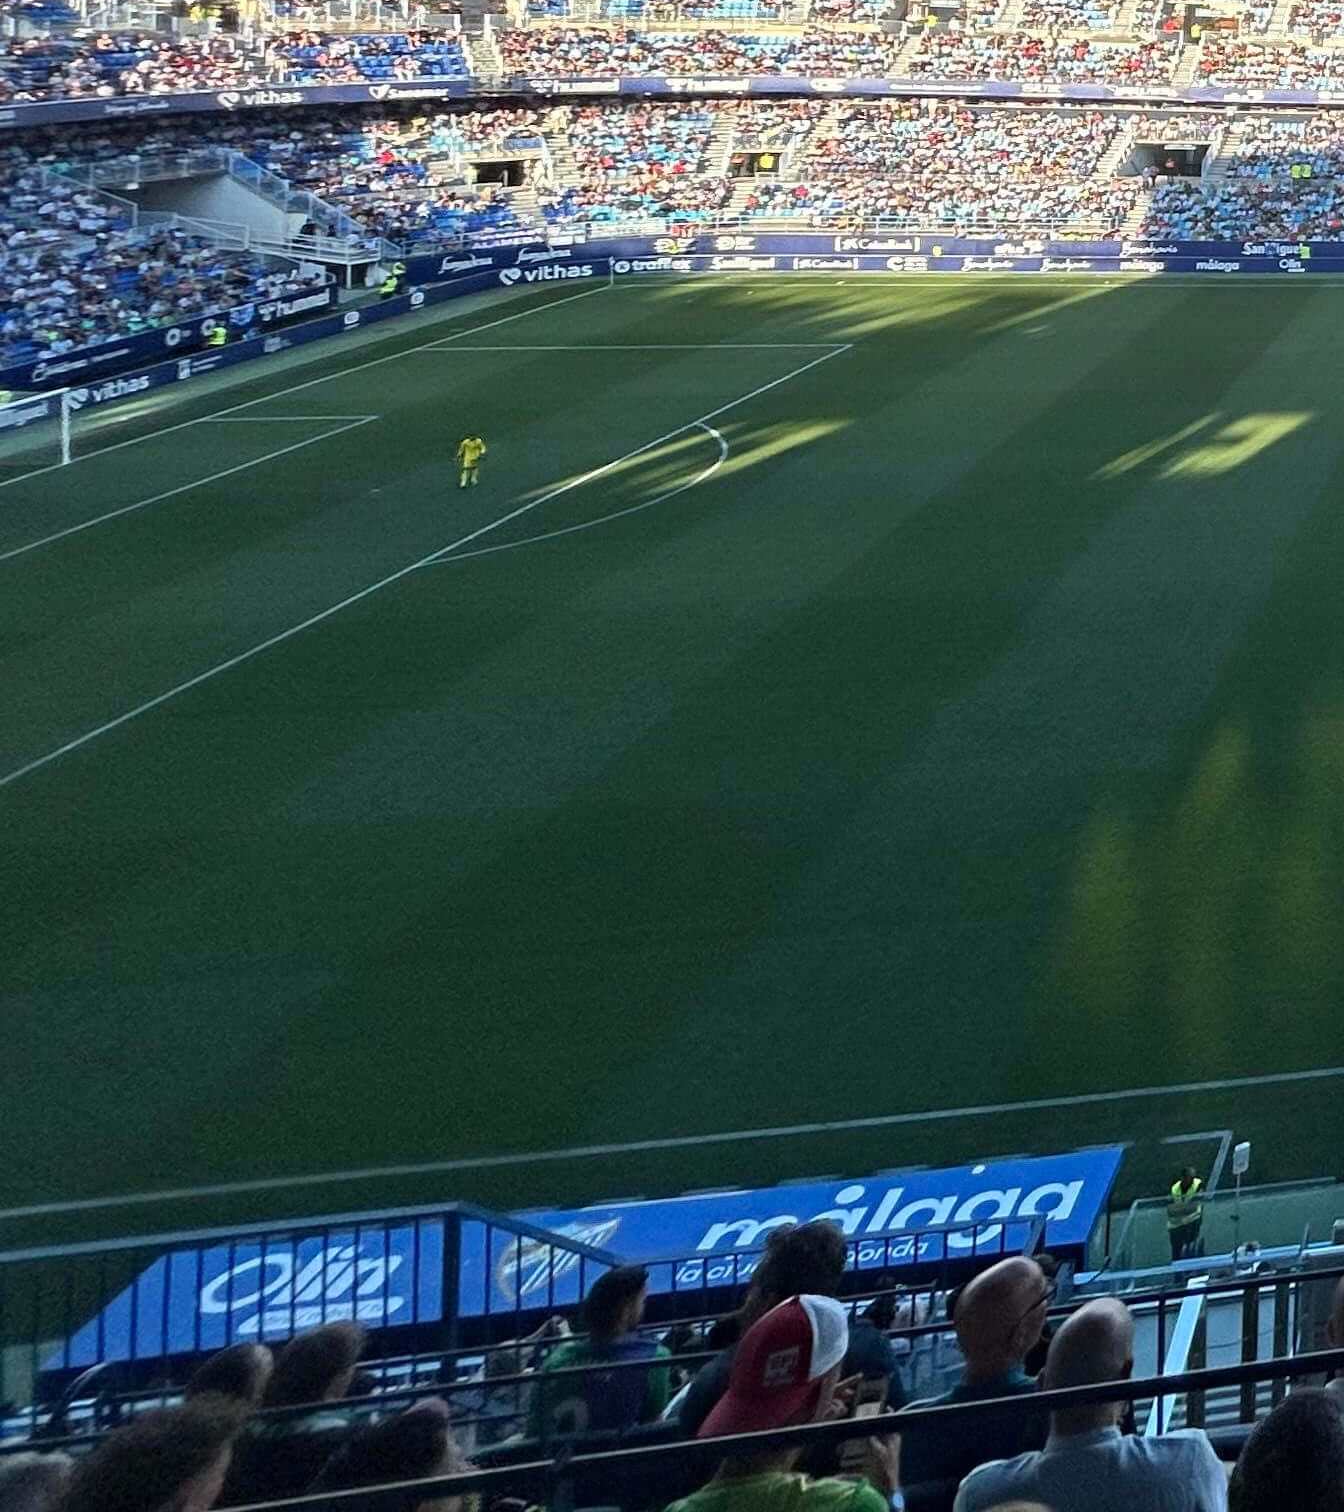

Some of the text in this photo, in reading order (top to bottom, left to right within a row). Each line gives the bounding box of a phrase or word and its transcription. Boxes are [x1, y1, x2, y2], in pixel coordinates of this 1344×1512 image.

[524, 263, 593, 281] vithas
[1196, 259, 1240, 272] málaga
[92, 374, 150, 402] vithas
[696, 1174, 1086, 1248] málaga
[199, 1244, 403, 1314] Olin
[675, 1260, 705, 1282] la
[706, 1254, 757, 1280] ciu
